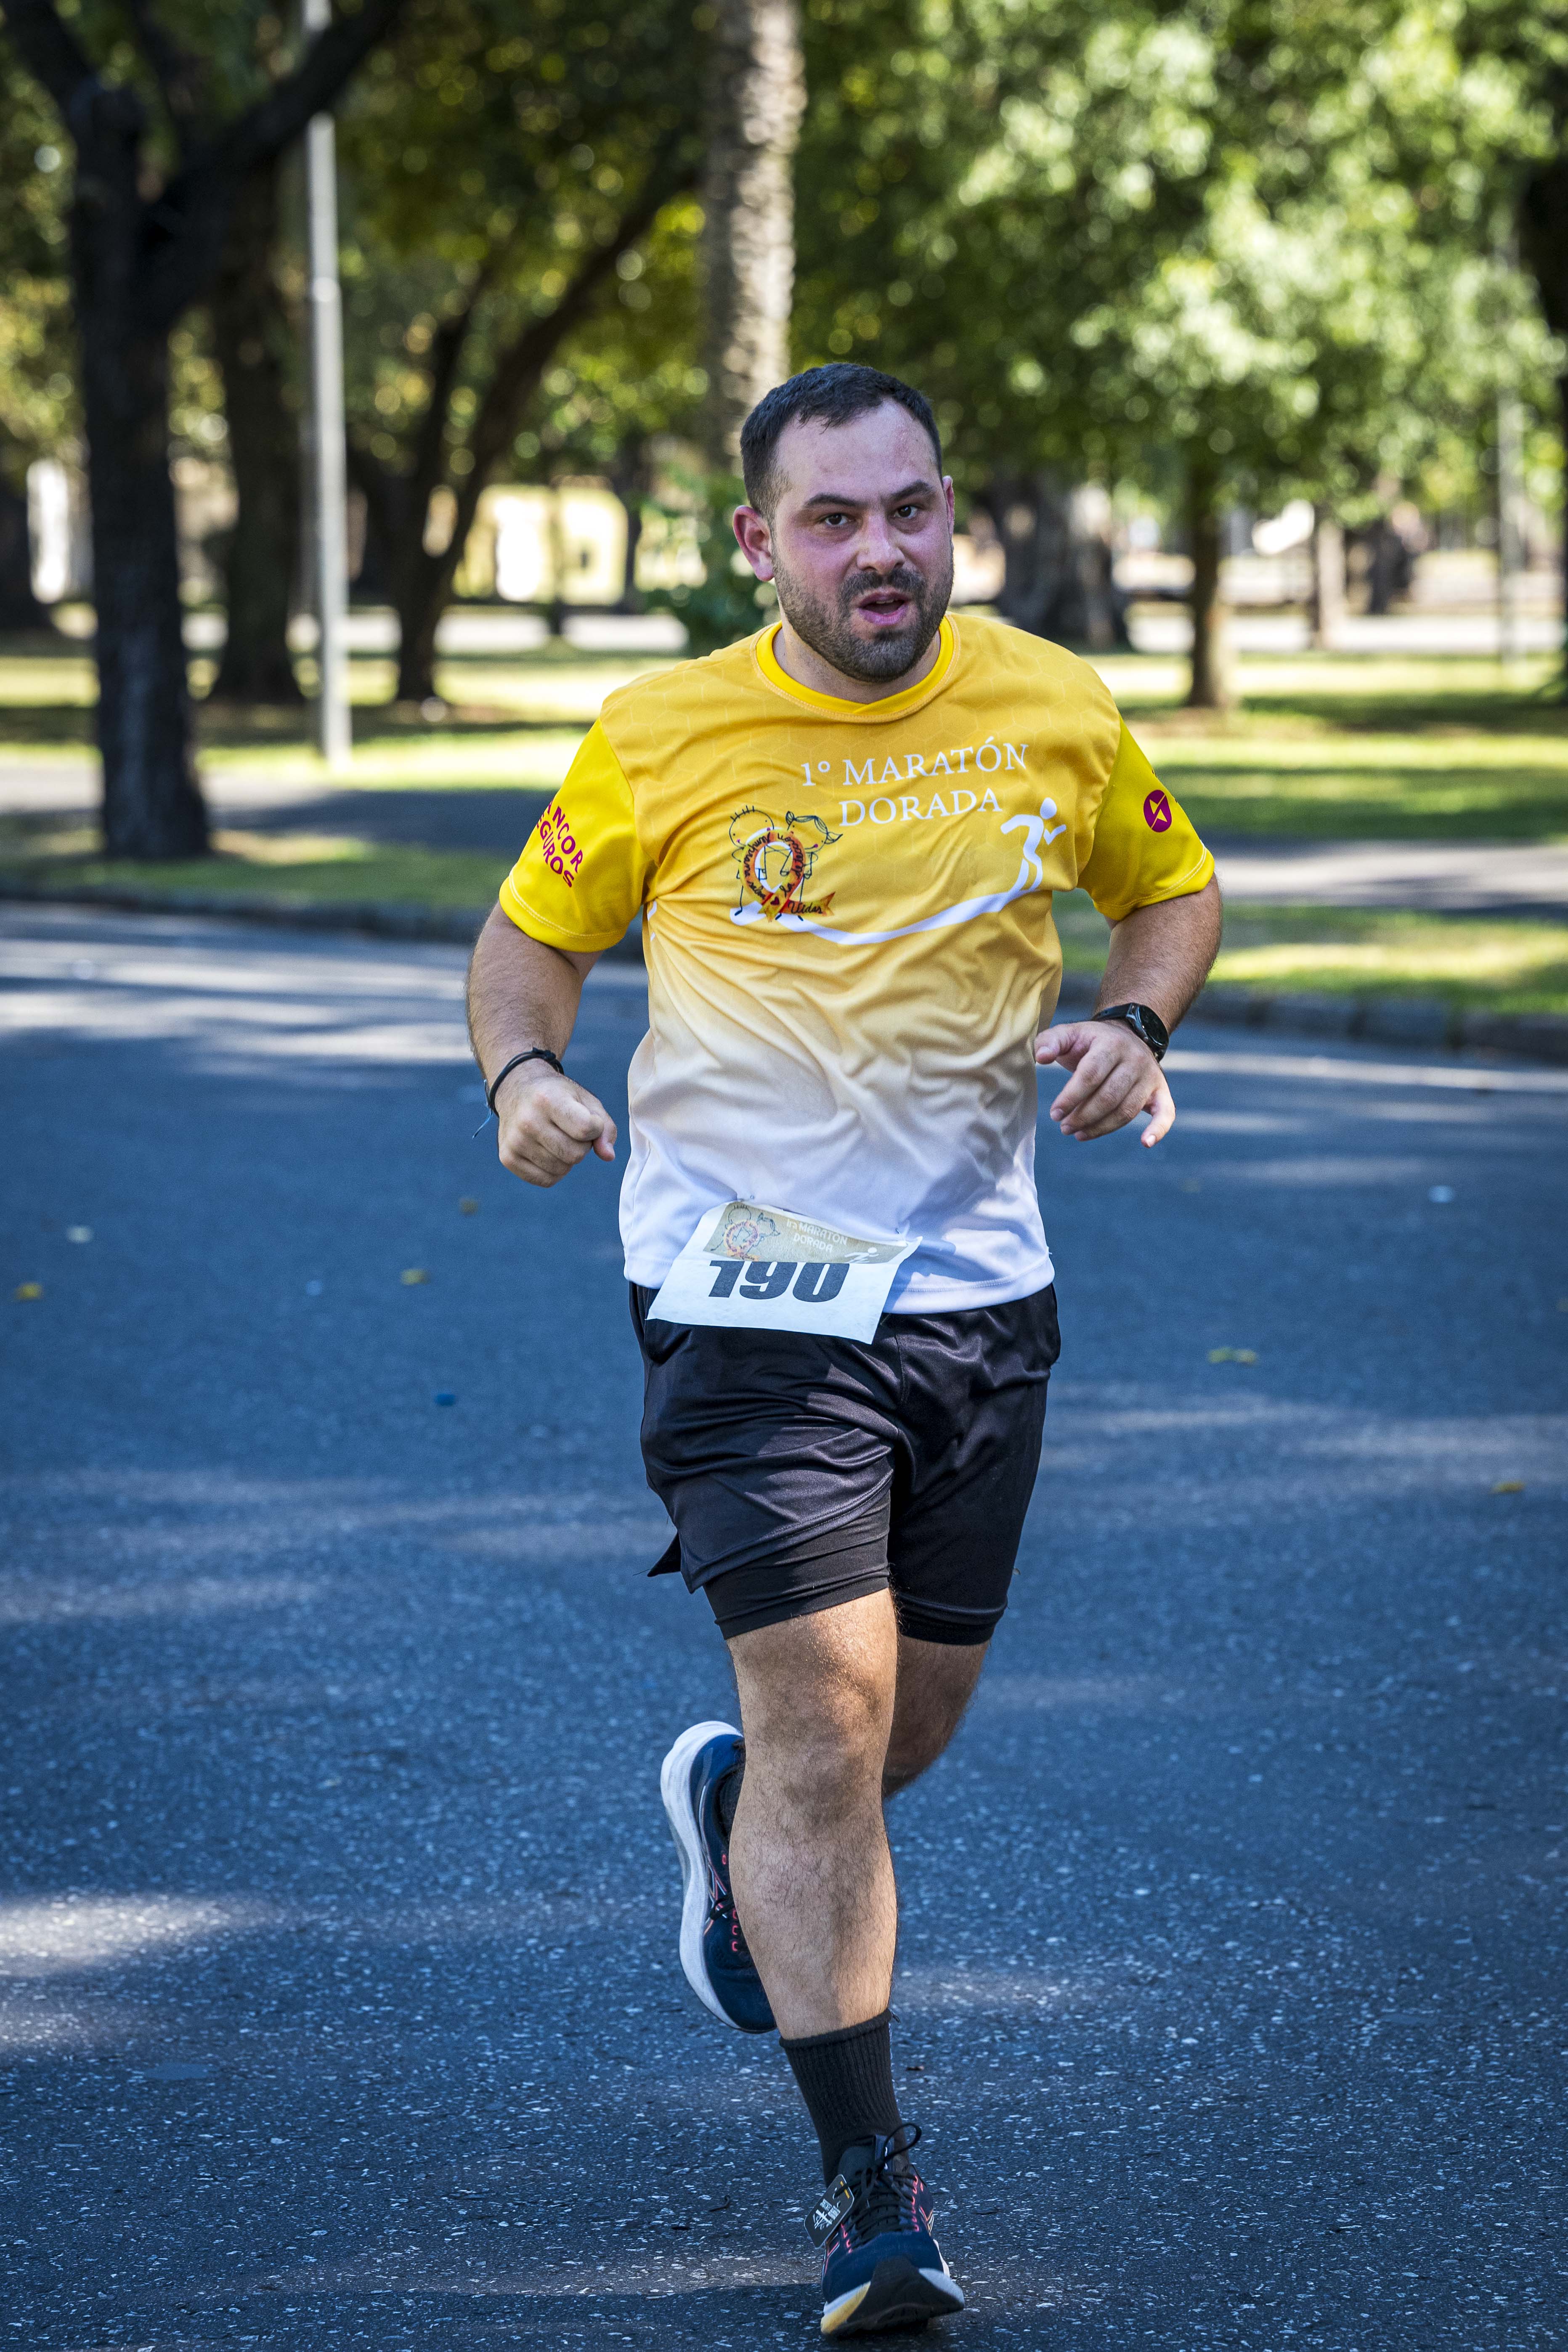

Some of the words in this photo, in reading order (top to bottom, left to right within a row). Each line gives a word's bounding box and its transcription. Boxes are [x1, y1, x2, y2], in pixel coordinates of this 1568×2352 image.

[843, 736, 1029, 786] MARATÓN
[839, 788, 1003, 827] DORADA
[793, 1232, 833, 1253] DORADA
[708, 1260, 850, 1302] 190
